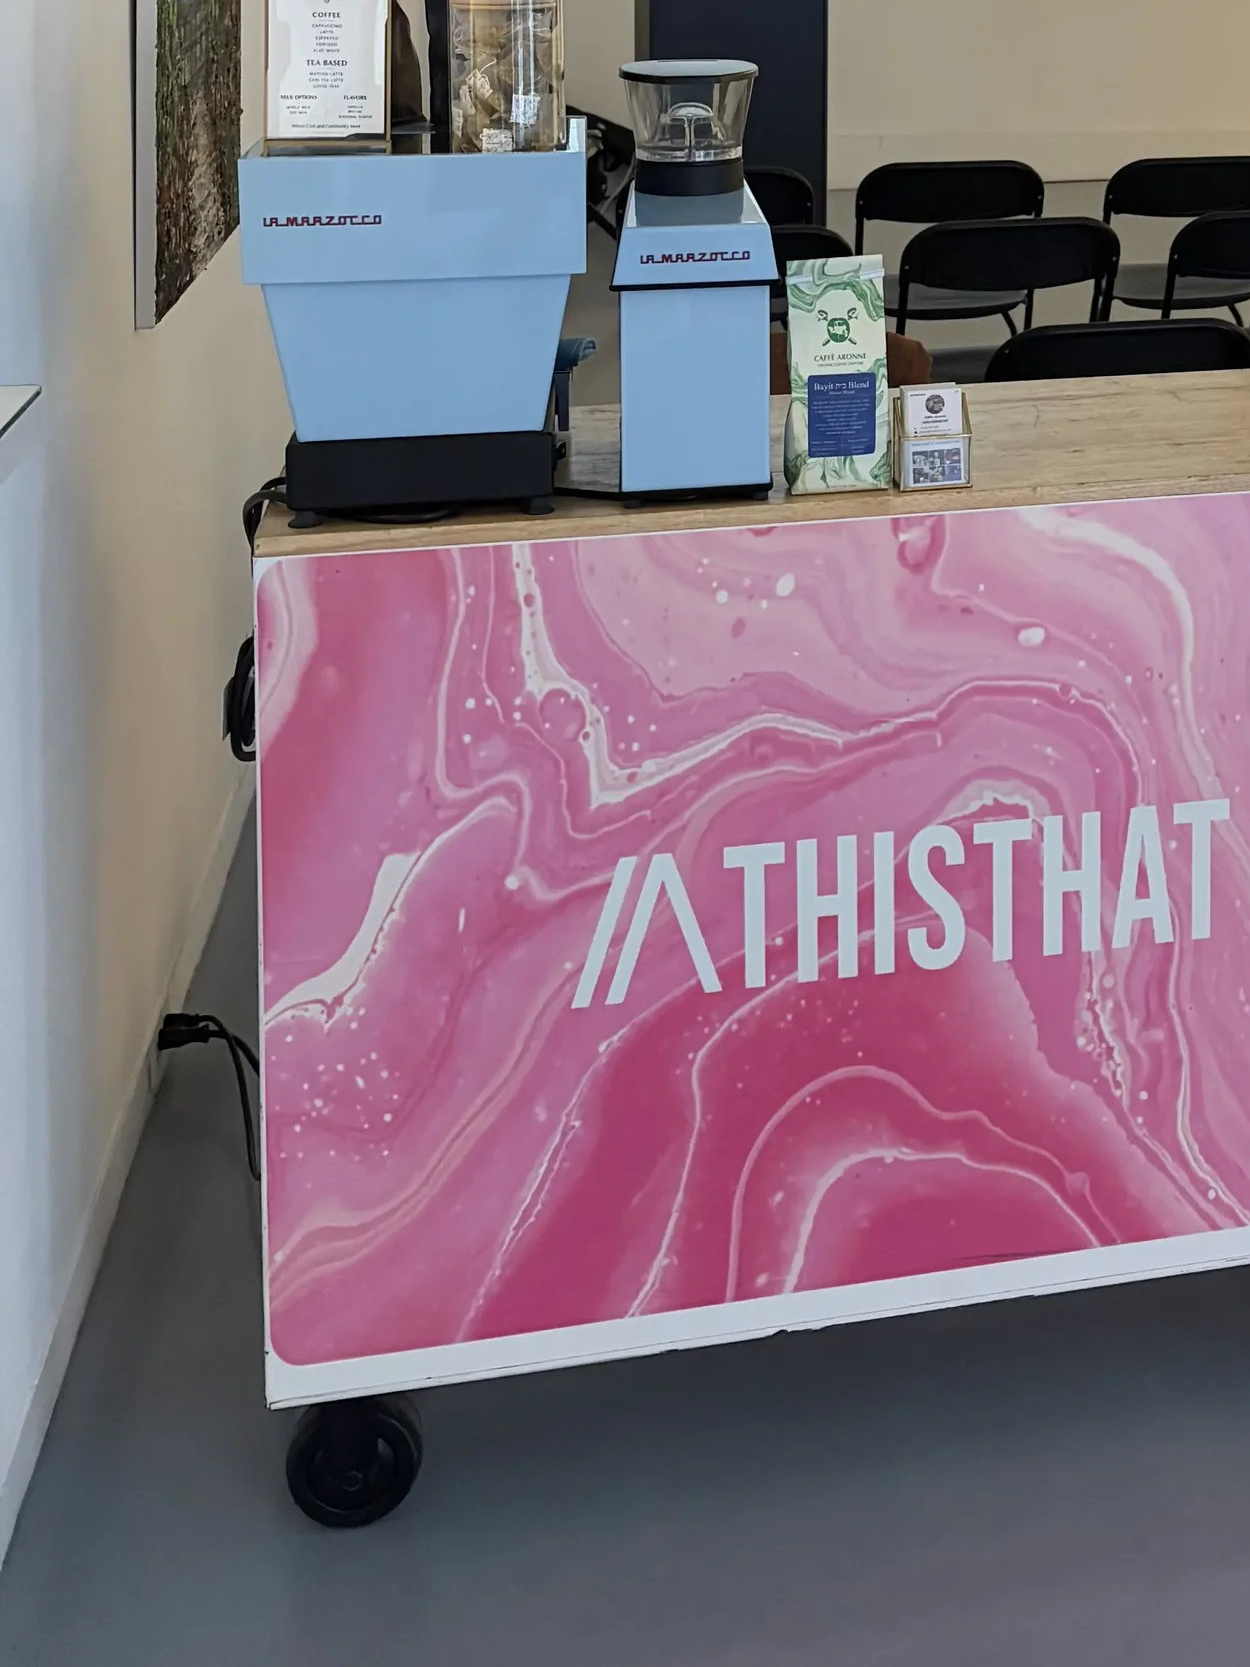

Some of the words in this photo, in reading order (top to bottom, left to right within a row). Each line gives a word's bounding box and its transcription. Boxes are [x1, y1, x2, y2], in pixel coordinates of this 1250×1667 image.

[312, 11, 342, 19] COFFEE
[306, 59, 321, 67] TEA
[322, 59, 348, 67] BASED
[263, 217, 278, 227] LA
[640, 255, 654, 264] LA
[848, 380, 870, 389] Blend
[723, 798, 1230, 989] THISTHAT
